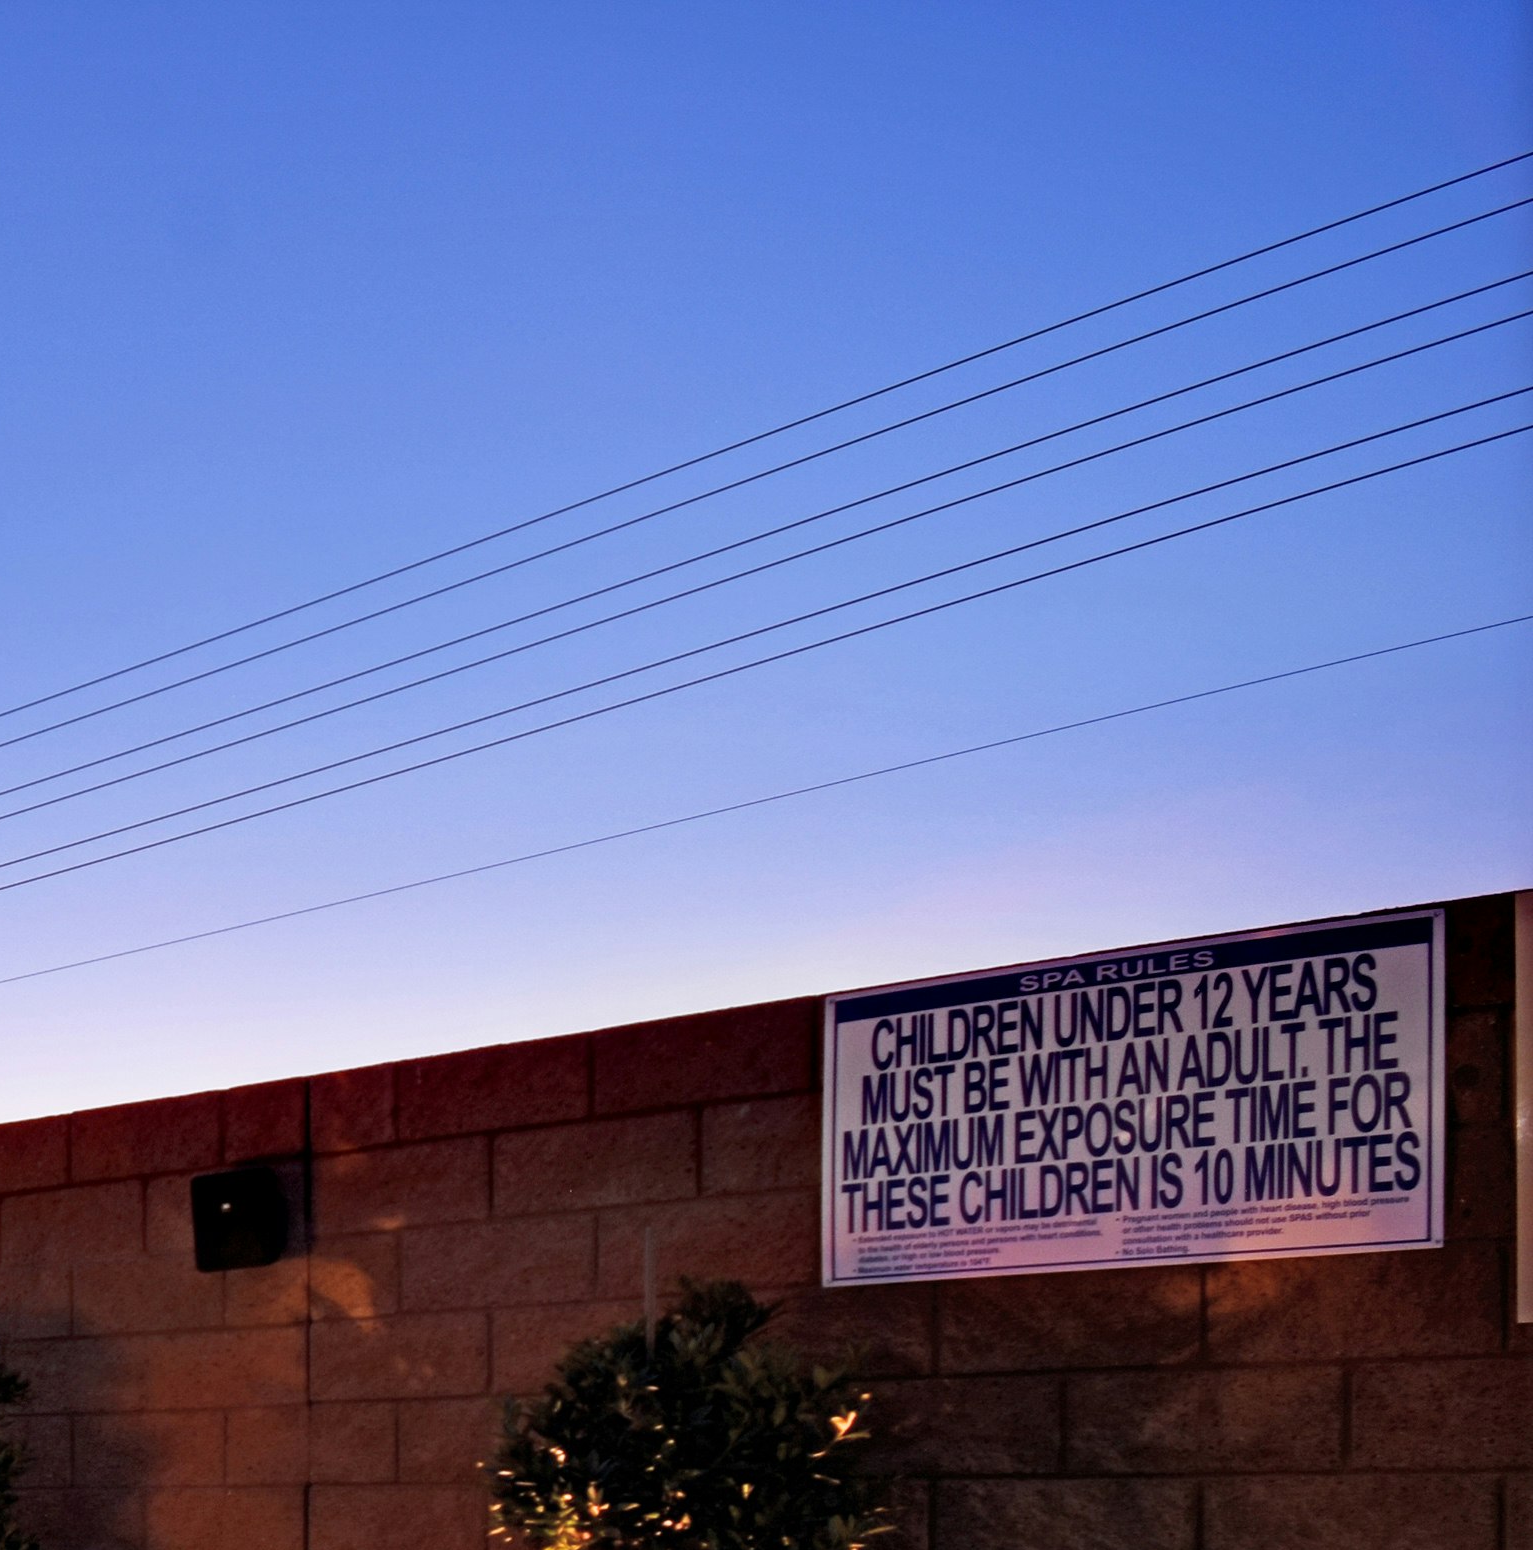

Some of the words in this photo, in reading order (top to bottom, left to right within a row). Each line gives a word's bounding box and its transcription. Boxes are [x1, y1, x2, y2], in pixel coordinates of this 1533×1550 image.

[1020, 969, 1085, 992] SPA
[1096, 950, 1214, 981] RULES
[872, 997, 1043, 1071] CHILDREN
[1054, 978, 1183, 1048] UNDER
[1194, 972, 1233, 1030] 12
[1241, 953, 1377, 1024] YEARS
[862, 1064, 955, 1126] MUST
[964, 1057, 1010, 1114] BE
[1018, 1046, 1108, 1107] WITH
[1116, 1037, 1169, 1098] AN
[1177, 1021, 1308, 1090] ADULT.
[1319, 1010, 1399, 1076] THE
[843, 1114, 1004, 1181] MAXIMUM
[1015, 1091, 1216, 1164] EXPOSURE
[1225, 1081, 1316, 1144] TIME
[1328, 1071, 1413, 1136] FOR
[842, 1174, 950, 1233] THESE
[959, 1156, 1139, 1224] CHILDREN
[1151, 1152, 1183, 1209] IS
[1195, 1148, 1234, 1205] 10
[1245, 1131, 1421, 1202] MINUTES
[1123, 1214, 1159, 1224] Pregnant
[1161, 1212, 1190, 1220] women
[1210, 1207, 1238, 1218] people
[1241, 1206, 1258, 1214] with
[1261, 1205, 1282, 1213] heart
[1321, 1200, 1341, 1210] high
[1343, 1198, 1368, 1207] blood
[1157, 1223, 1182, 1231] health
[1184, 1220, 1222, 1230] problems
[1224, 1217, 1253, 1226] should
[1289, 1213, 1312, 1222] SPAS
[1316, 1211, 1348, 1220] without
[1349, 1209, 1371, 1219] prior
[913, 1241, 938, 1250] elderly
[939, 1239, 969, 1248] persons
[971, 1237, 985, 1245] and
[987, 1236, 1018, 1245] persons
[1038, 1232, 1057, 1240] heart
[937, 1229, 953, 1237] HOT
[956, 1227, 983, 1236] WATER
[995, 1225, 1021, 1235] vapors
[1023, 1224, 1039, 1232] may
[1122, 1235, 1172, 1245] consultation
[1174, 1233, 1192, 1241] with
[1201, 1229, 1245, 1238] healthcare
[943, 1249, 964, 1257] blood
